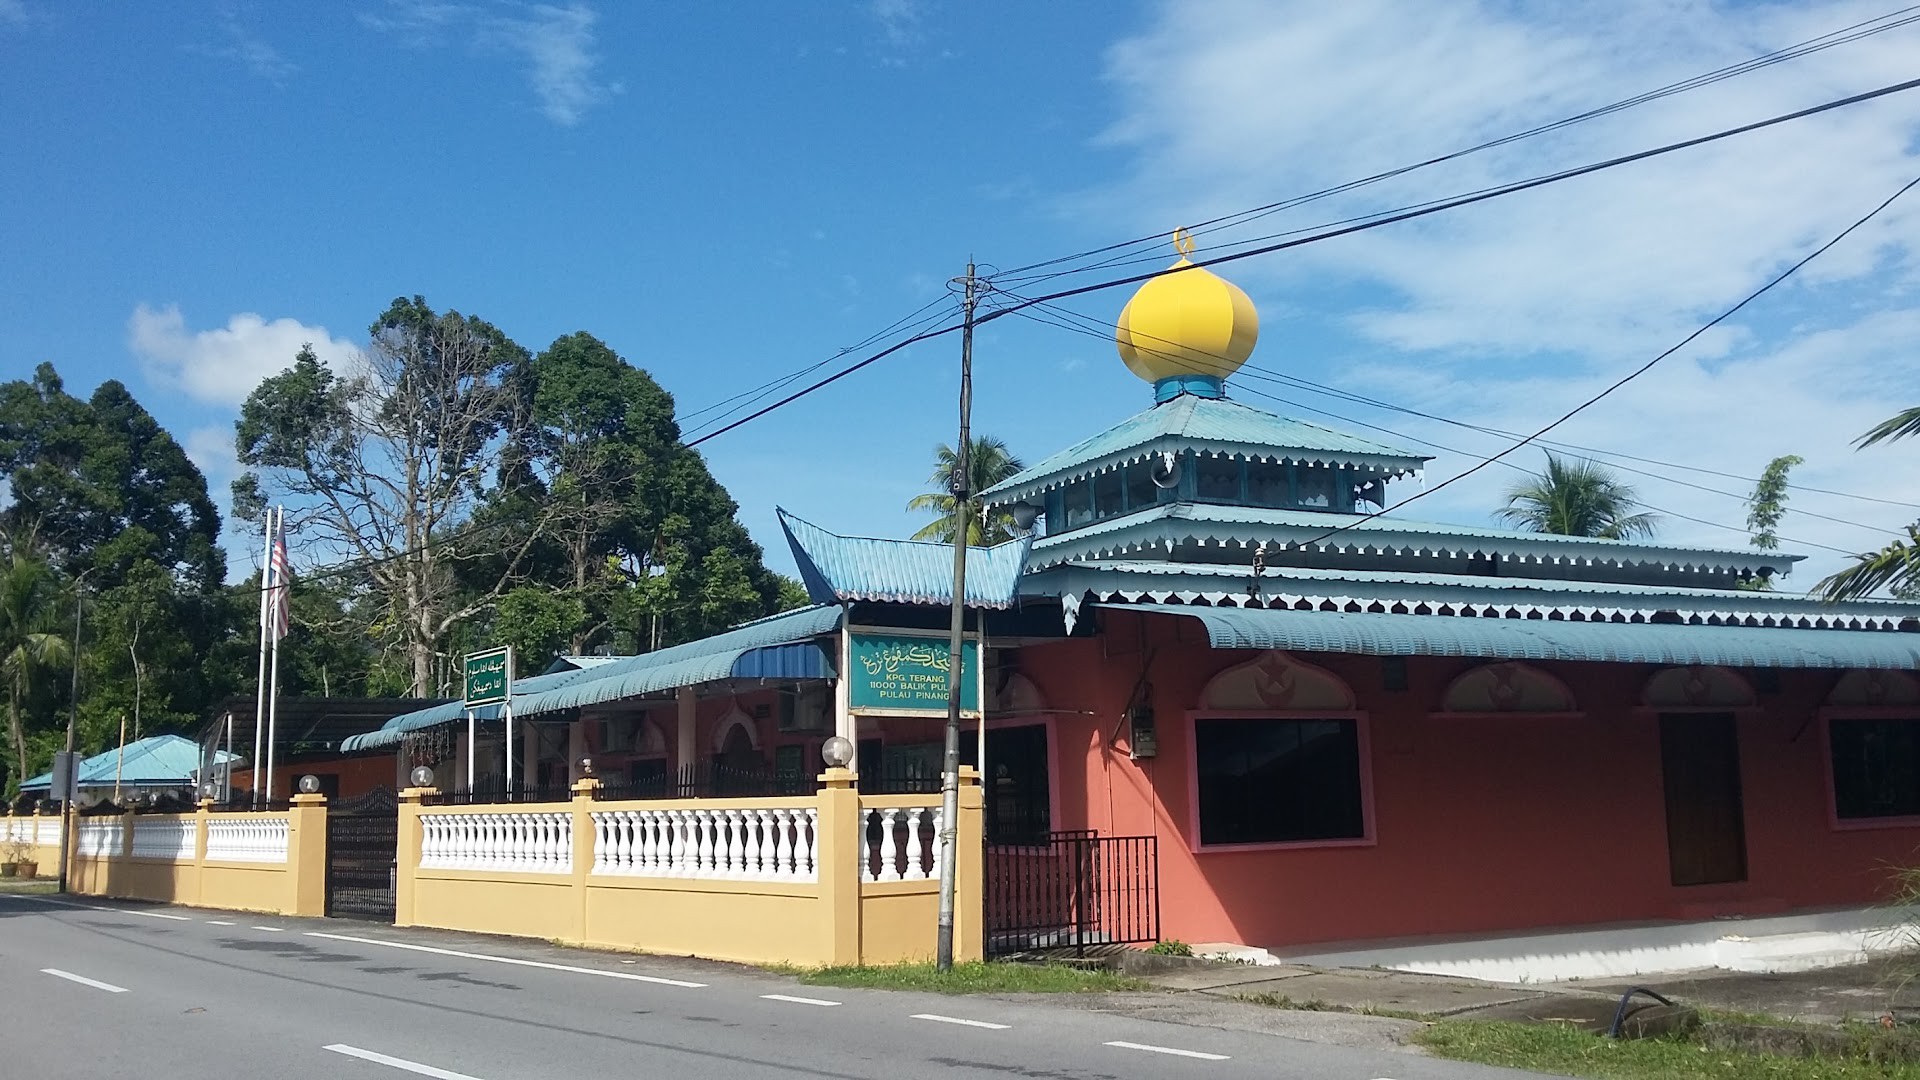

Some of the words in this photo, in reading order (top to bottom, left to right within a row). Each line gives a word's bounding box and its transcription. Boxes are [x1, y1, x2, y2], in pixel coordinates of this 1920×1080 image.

[909, 675, 945, 683] TERANG
[870, 681, 896, 690] 11000
[900, 682, 926, 690] BALIK
[930, 683, 949, 691] PUL
[880, 690, 911, 699] PULAU
[916, 692, 950, 700] PINANG
